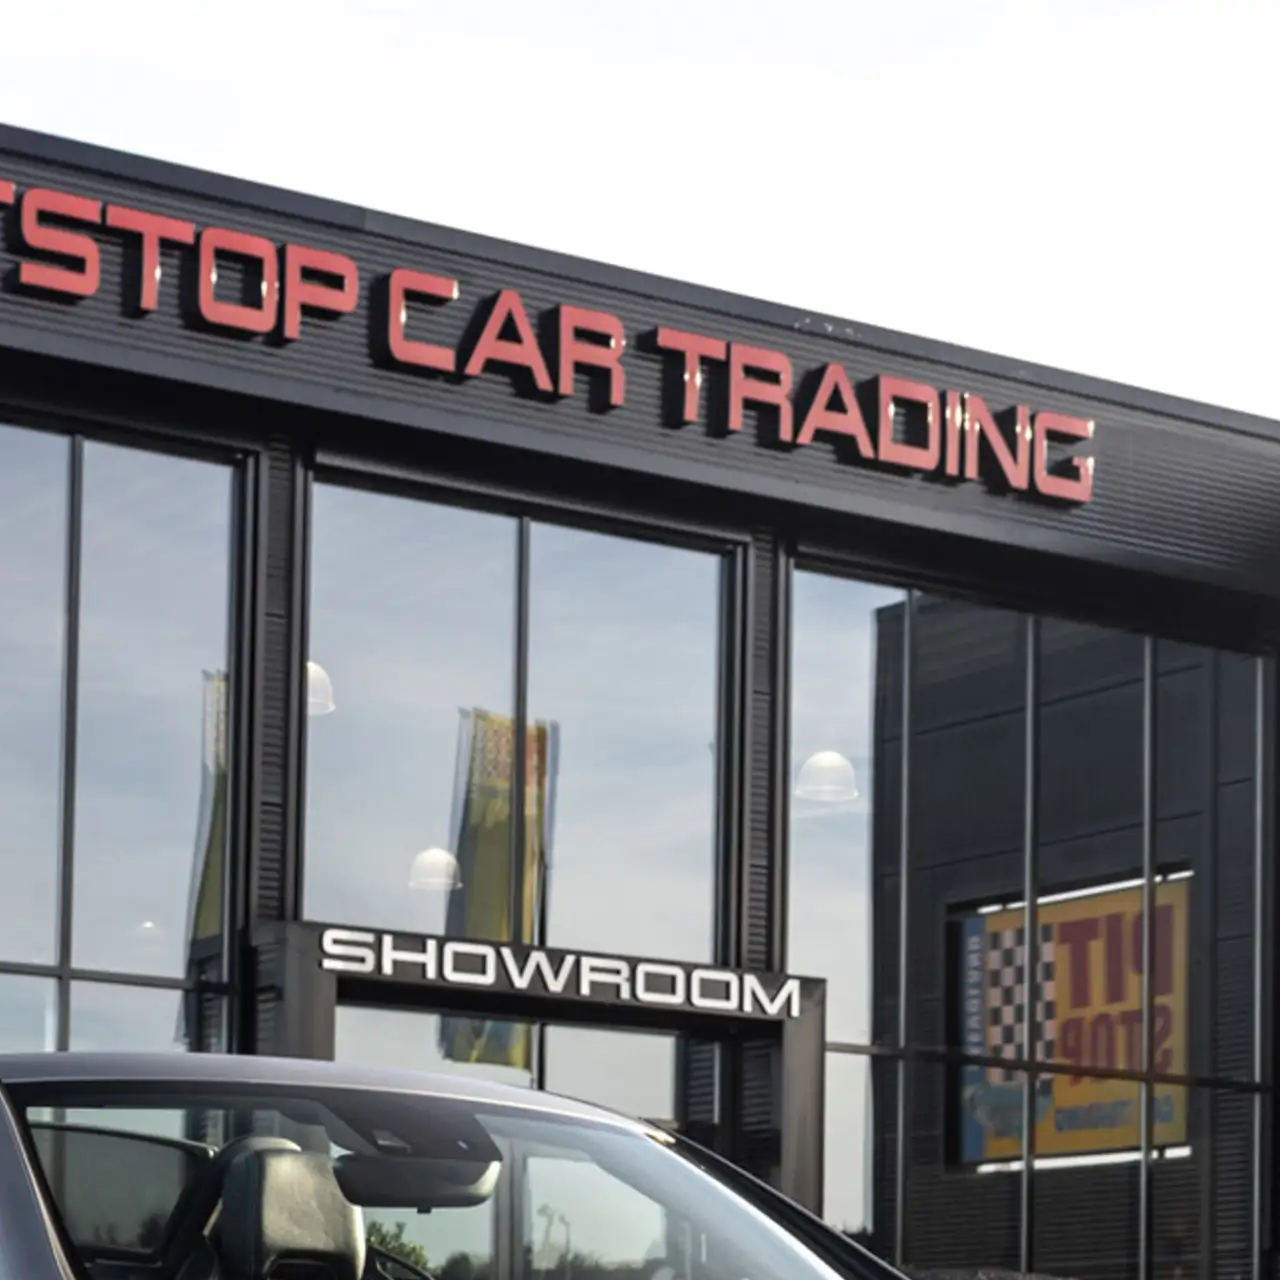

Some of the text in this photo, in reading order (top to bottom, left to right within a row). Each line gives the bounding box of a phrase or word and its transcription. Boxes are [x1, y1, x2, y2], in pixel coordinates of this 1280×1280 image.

[387, 268, 626, 406] CAR
[656, 327, 1095, 503] TRADING
[320, 928, 801, 1018] SHOWROOM
